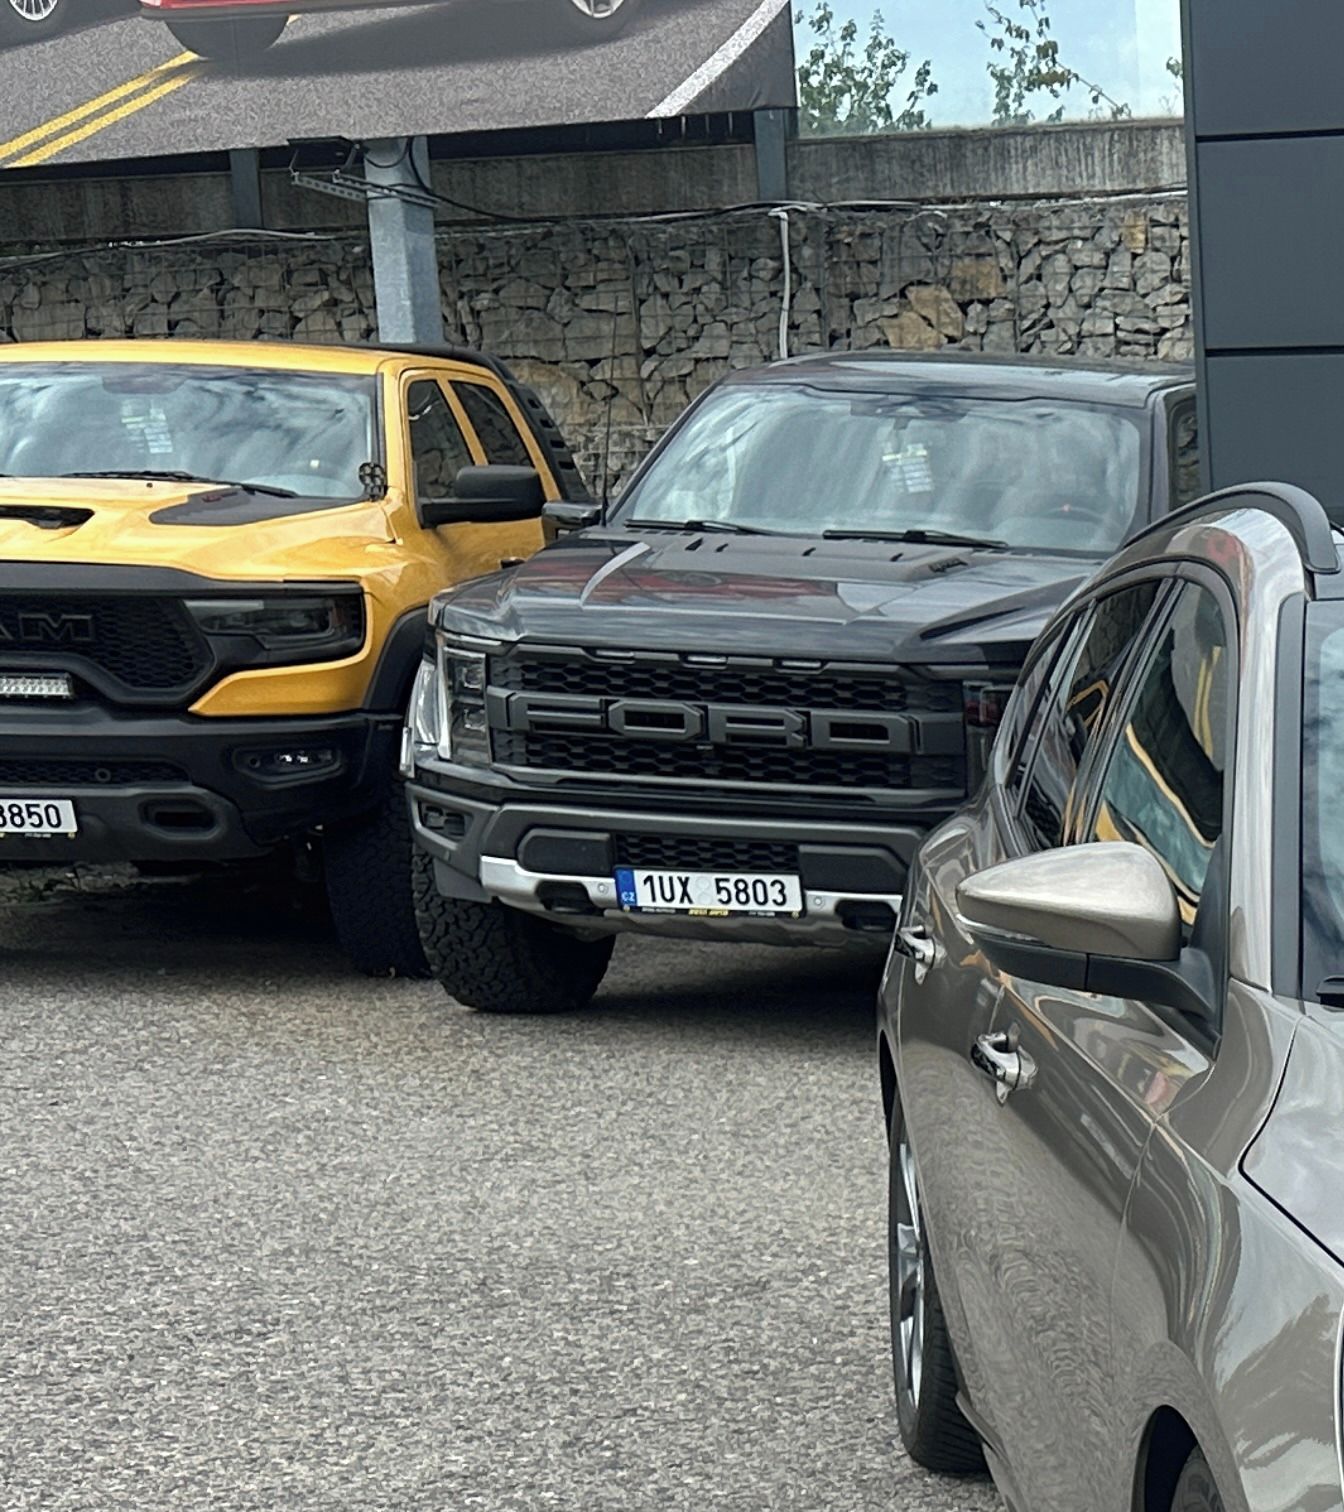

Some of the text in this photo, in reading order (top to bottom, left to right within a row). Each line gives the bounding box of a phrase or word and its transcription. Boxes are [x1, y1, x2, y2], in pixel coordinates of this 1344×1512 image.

[508, 691, 921, 754] FORD
[621, 891, 635, 902] CZ
[643, 874, 788, 906] 1UX 5803
